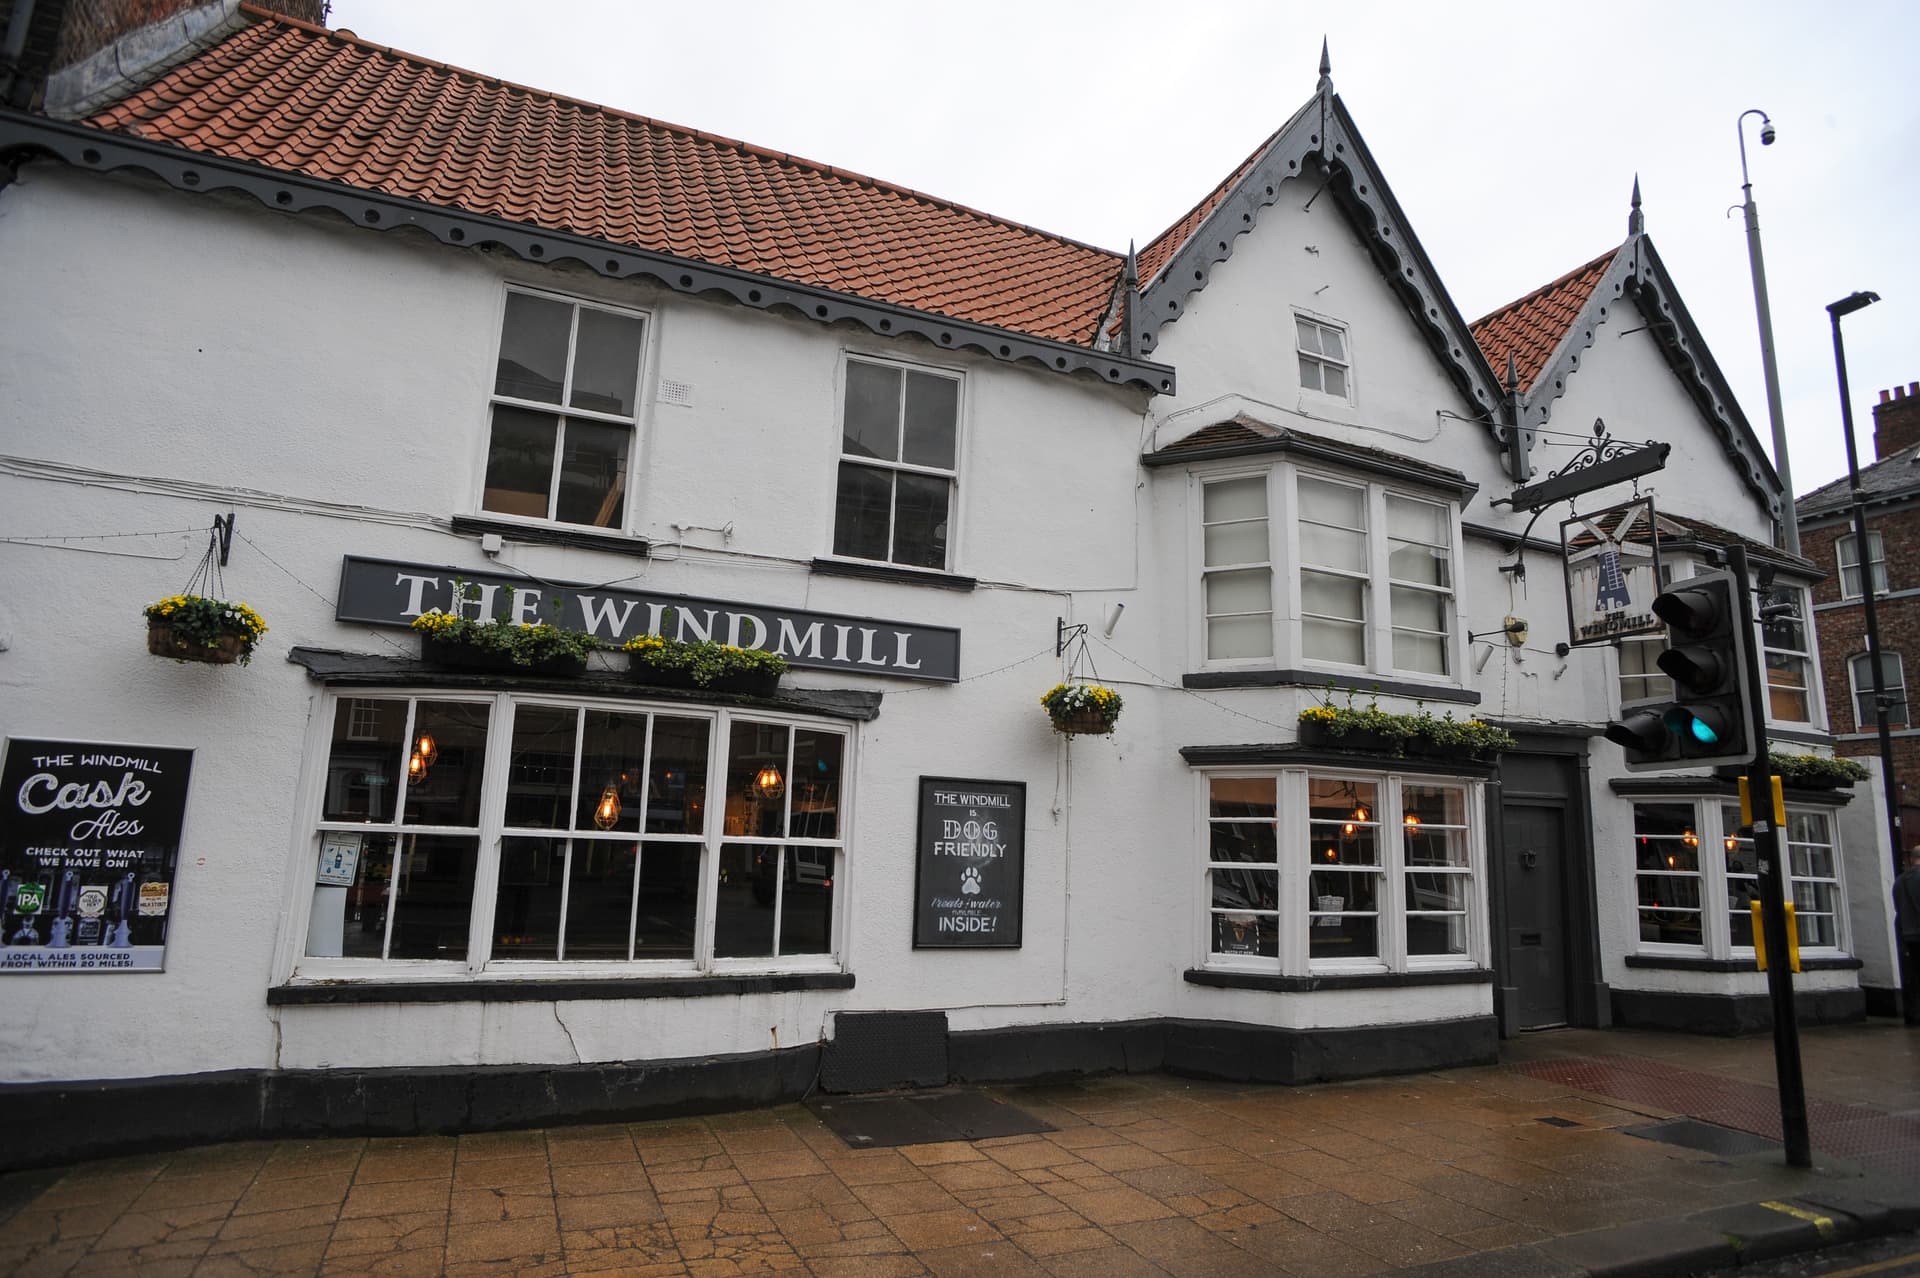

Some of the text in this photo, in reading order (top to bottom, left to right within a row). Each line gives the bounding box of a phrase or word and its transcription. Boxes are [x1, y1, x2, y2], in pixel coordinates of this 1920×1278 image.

[395, 573, 922, 670] THE WINDMILL
[1580, 614, 1654, 637] WINDMILL
[32, 755, 163, 773] THE WINDMILL
[18, 772, 152, 815] Cask
[934, 793, 1011, 807] THE WINDMILL
[969, 809, 977, 817] IS
[71, 809, 145, 841] Ales
[943, 820, 997, 840] DOG
[26, 847, 145, 859] CHECK OUT WHAT
[934, 842, 1007, 857] FRIENDLY
[39, 857, 129, 868] WE HAVE ON!
[17, 893, 40, 906] IPA
[970, 899, 1002, 908] water
[939, 916, 997, 932] INSIDE!
[1, 960, 32, 968] FROM
[38, 960, 76, 968] WITHIN
